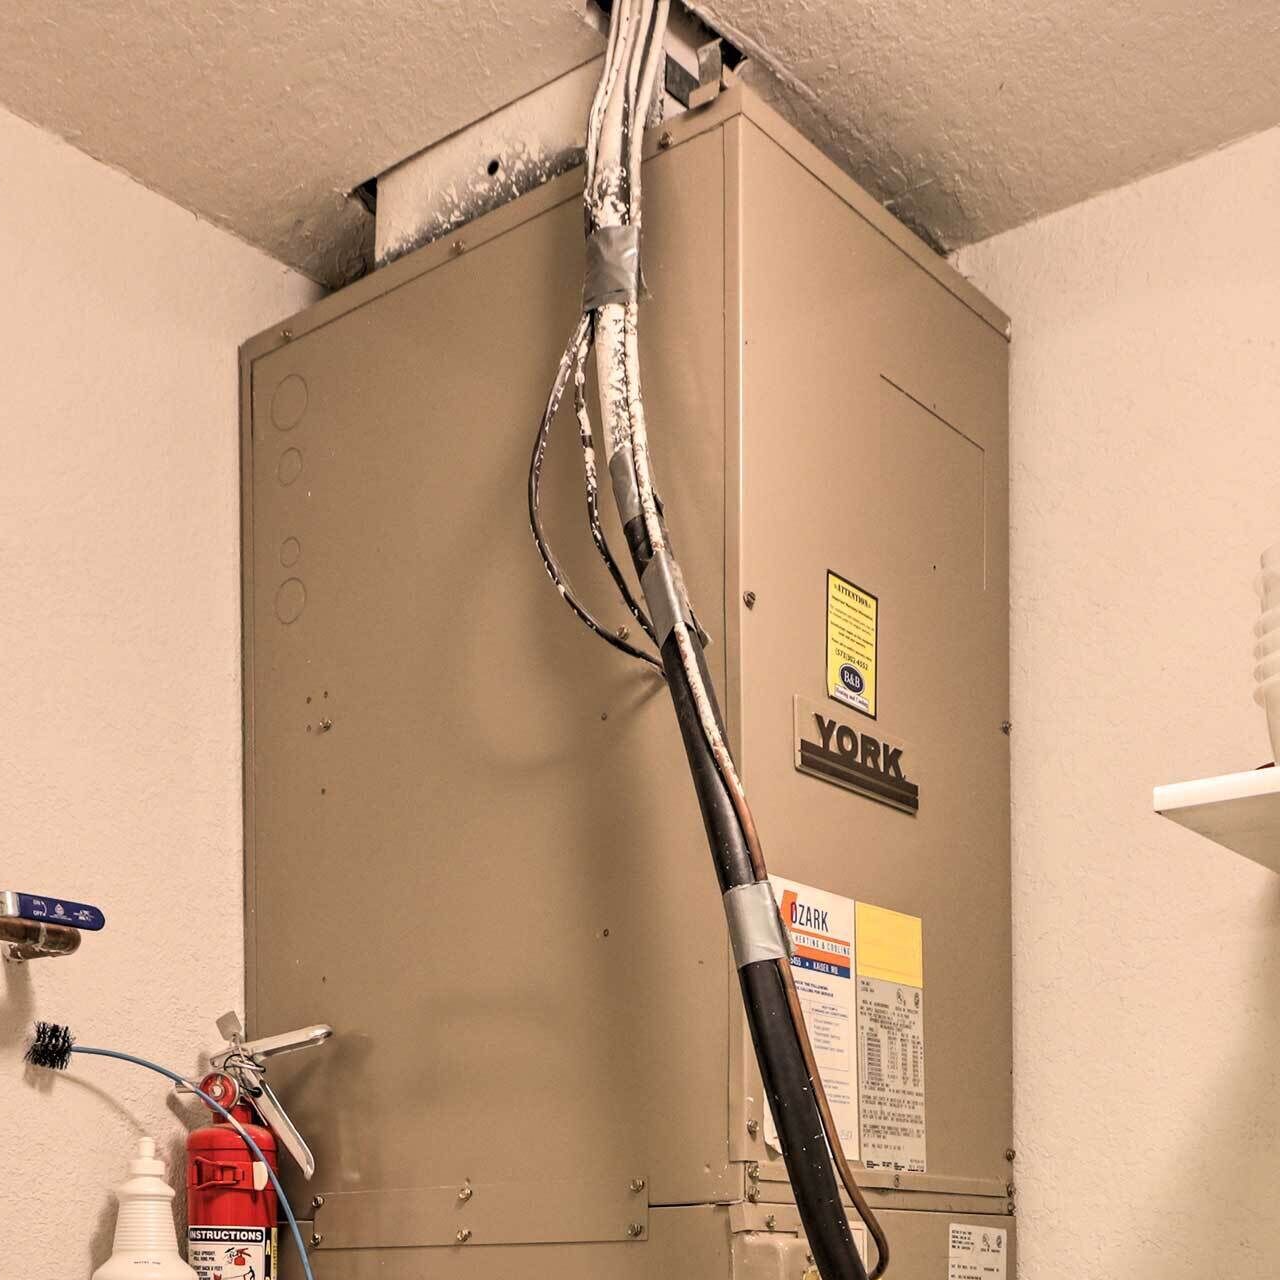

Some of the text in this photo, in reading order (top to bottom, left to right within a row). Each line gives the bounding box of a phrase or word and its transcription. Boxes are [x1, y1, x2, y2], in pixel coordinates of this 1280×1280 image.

[844, 670, 861, 689] B&B
[814, 712, 903, 780] YORK
[791, 901, 829, 932] OZARK
[190, 1230, 262, 1240] INSTRUCTIONS
[266, 1240, 270, 1255] A
